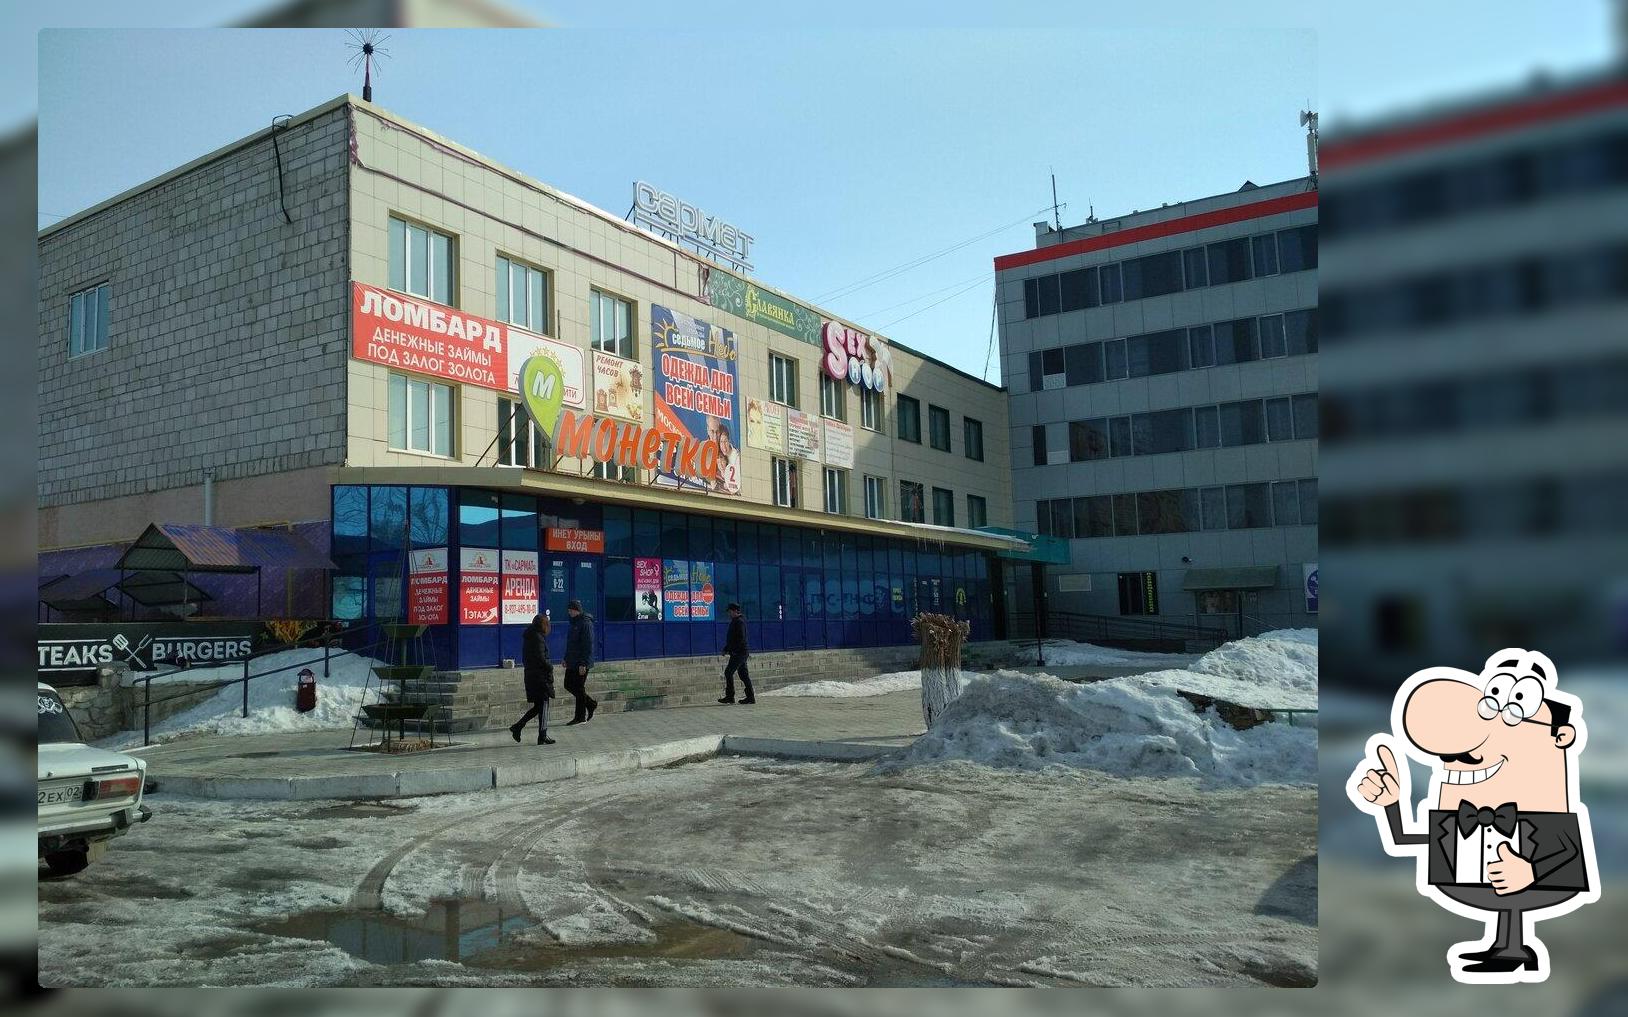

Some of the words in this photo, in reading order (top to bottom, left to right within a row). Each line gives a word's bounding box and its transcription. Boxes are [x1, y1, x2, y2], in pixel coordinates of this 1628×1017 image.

[361, 290, 502, 353] ЛОМБАРД
[372, 326, 445, 356] ДЕНЕЖНЫЕ
[447, 345, 492, 367] ЗАЙМЫ
[368, 343, 400, 366] ПОД
[402, 353, 446, 373] ЗАЛОГ
[447, 364, 496, 385] ЗОЛОТА
[596, 355, 624, 369] РЕМОНТ
[597, 366, 619, 378] ЧАСОВ
[661, 353, 710, 388] ОДЕЖДА
[711, 369, 734, 395] ДЛЯ
[665, 382, 695, 411] ВСЕЙ
[695, 390, 732, 418] СЕМЬИ
[729, 466, 736, 482] 2
[566, 541, 588, 552] ВХОД
[462, 576, 499, 585] ЛОМБАРД
[504, 577, 536, 600] АРЕНДА
[465, 587, 494, 595] ДЕНЕЖНЫЕ
[463, 607, 468, 620] 1
[468, 610, 489, 620] ЭТАЖ
[38, 644, 113, 666] TEAKS
[152, 640, 252, 661] BURGERS
[66, 787, 80, 798] 02
